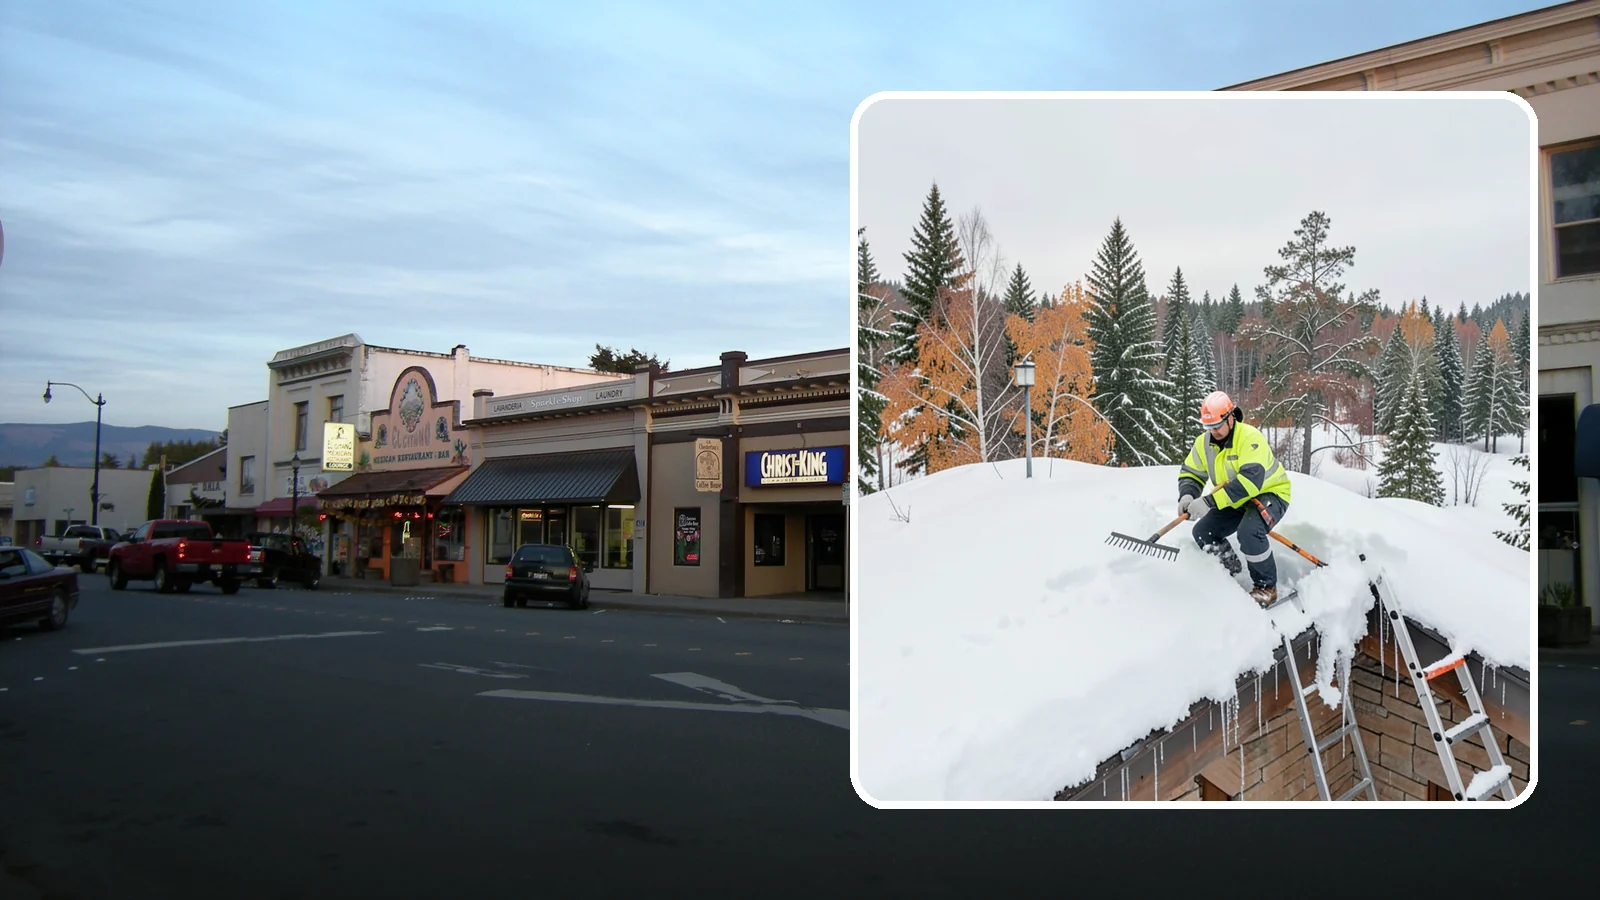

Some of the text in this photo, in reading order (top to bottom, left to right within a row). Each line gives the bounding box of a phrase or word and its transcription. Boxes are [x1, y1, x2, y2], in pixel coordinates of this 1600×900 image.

[595, 389, 623, 400] LAUNDRY
[493, 402, 523, 413] LAVANDERIA
[531, 394, 582, 409] Sparkle Shop
[374, 454, 396, 464] MEXICAN
[397, 452, 433, 463] RESTAURANT
[438, 450, 450, 459] BAR
[761, 450, 828, 478] CHRIST KING
[696, 481, 722, 489] Coffee House
